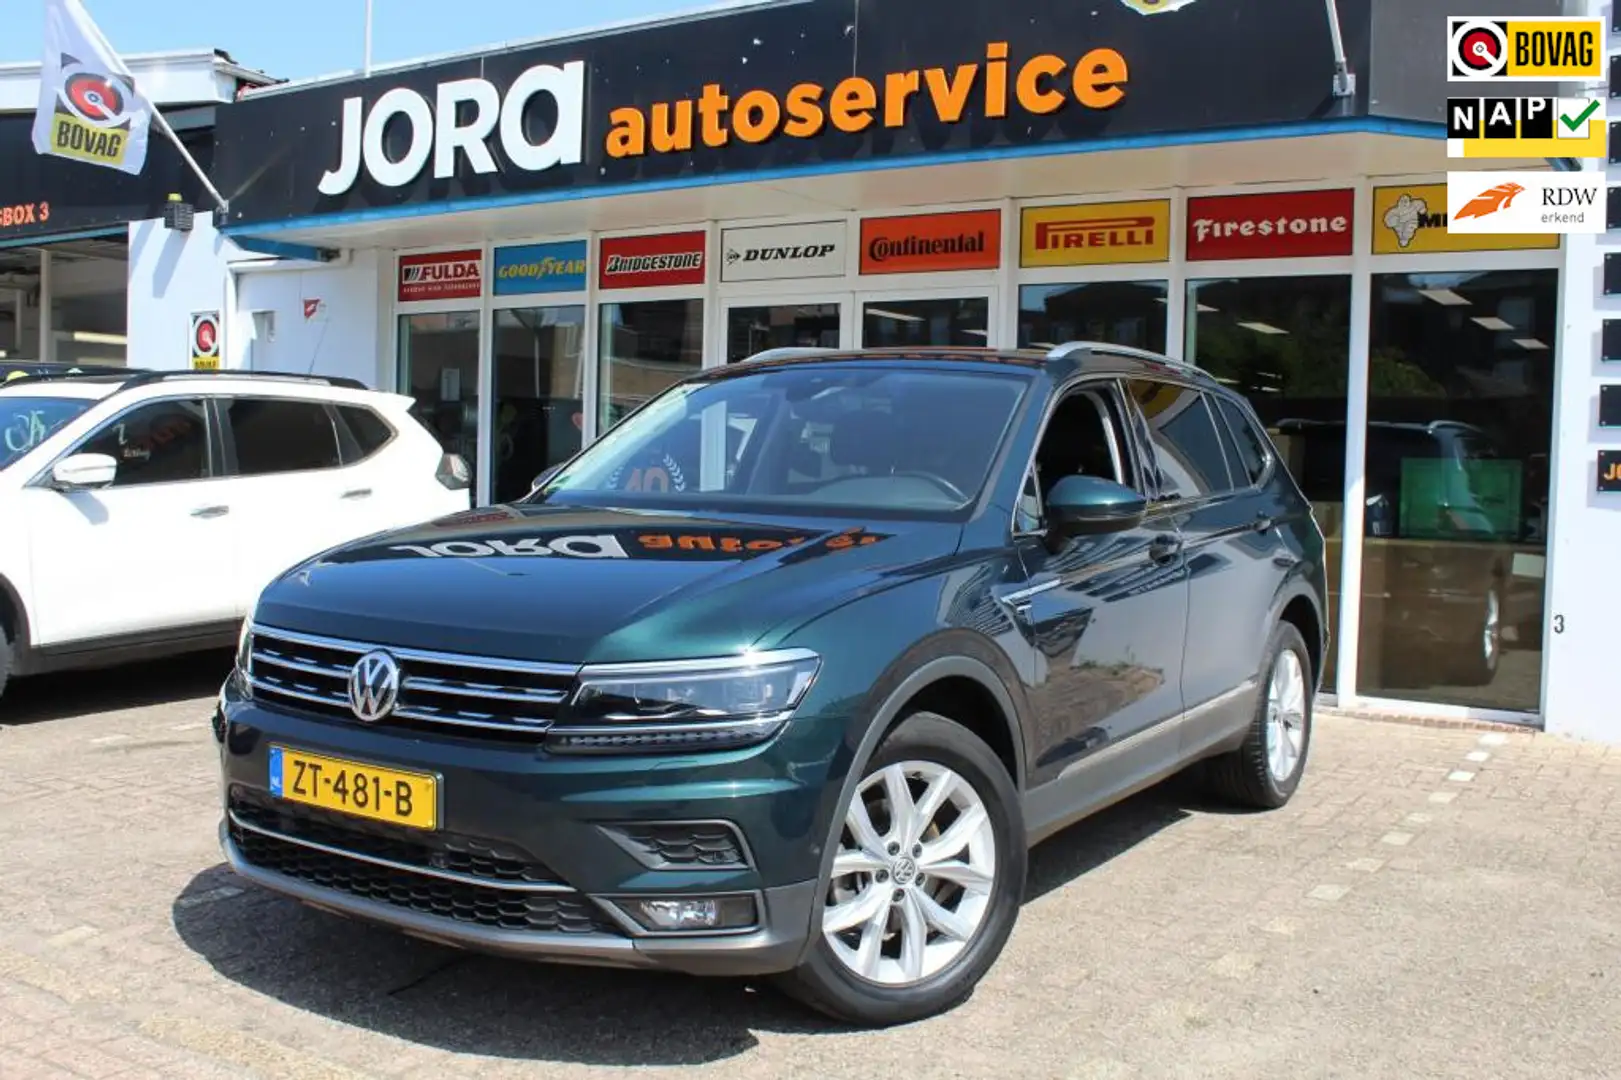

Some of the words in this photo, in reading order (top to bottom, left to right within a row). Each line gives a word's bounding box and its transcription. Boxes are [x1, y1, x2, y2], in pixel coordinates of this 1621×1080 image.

[605, 42, 1129, 158] autoservice
[56, 119, 123, 159] BOVAG
[39, 201, 50, 222] 3
[868, 230, 985, 262] Continental
[1034, 216, 1156, 251] PIRELLI
[606, 252, 701, 274] BRIDGESTONE
[742, 244, 836, 262] DUNLOP
[419, 264, 480, 281] FULDA
[1553, 614, 1565, 635] 3
[292, 759, 413, 817] ZT-481-B
